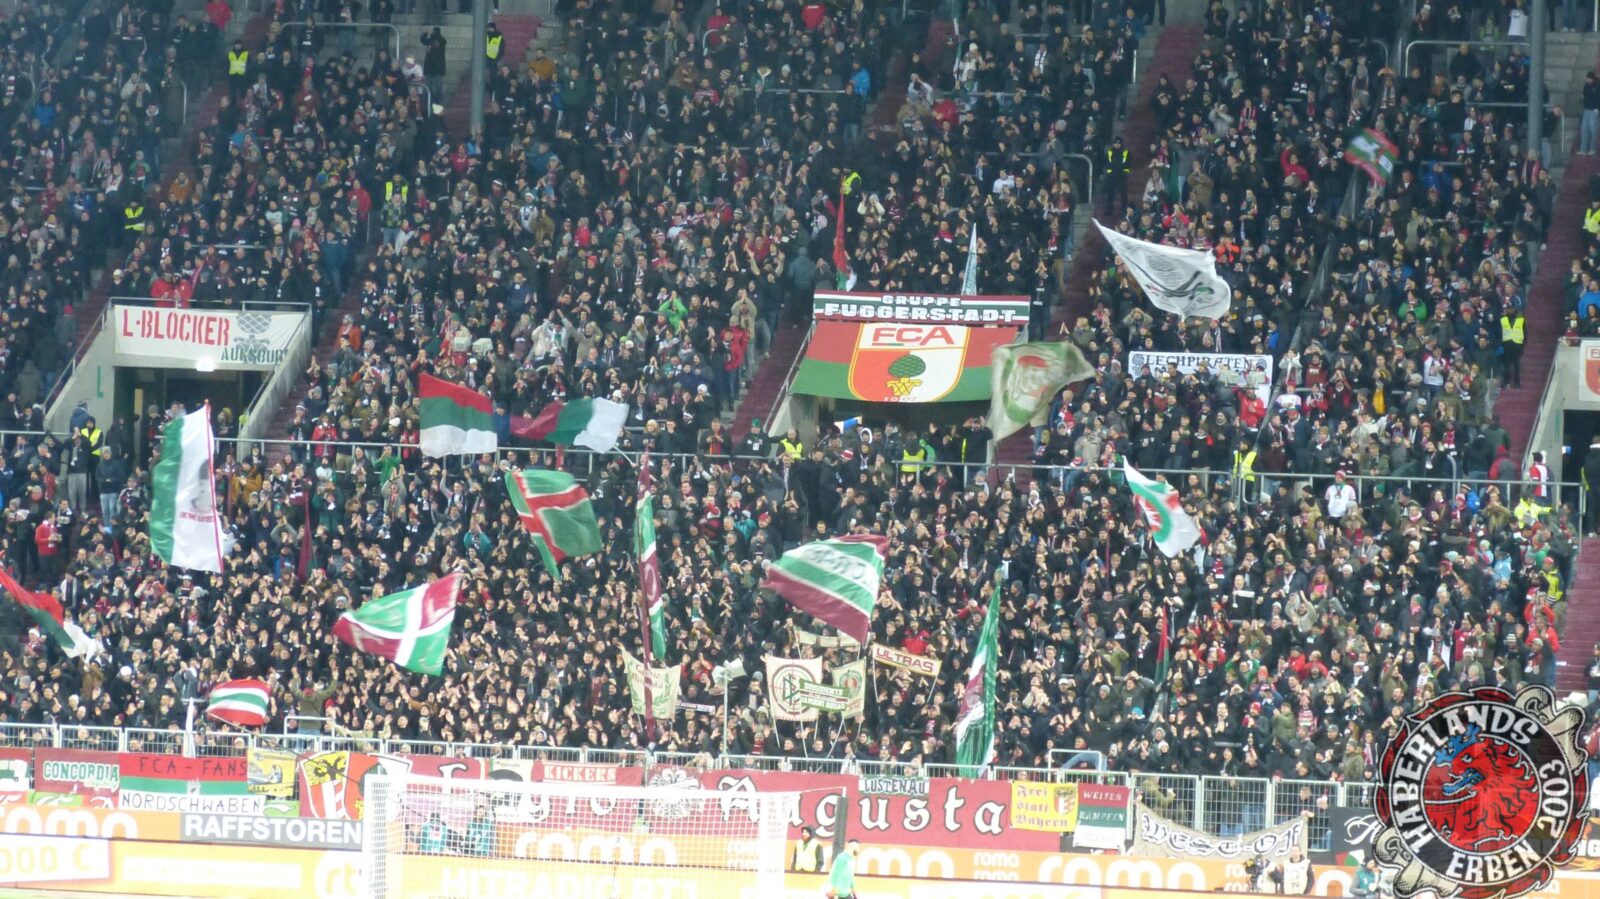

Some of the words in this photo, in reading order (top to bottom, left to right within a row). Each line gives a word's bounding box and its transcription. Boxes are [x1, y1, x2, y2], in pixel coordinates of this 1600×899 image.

[879, 294, 961, 307] GRUPPE
[823, 303, 1017, 323] FUGGERSTADT
[871, 326, 955, 346] FCA
[221, 346, 288, 366] AUGSBUR
[1146, 354, 1253, 370] LECHPIRATEN
[876, 647, 934, 673] ULTRAS
[44, 762, 119, 782] CONCORDIA
[139, 757, 178, 774] FCA
[202, 760, 248, 776] FANS
[543, 765, 618, 782] KICKERS
[864, 778, 926, 794] LUSTENAU
[121, 793, 262, 814] NORDSCHWABEN
[185, 814, 363, 846] RAFFSTOREN
